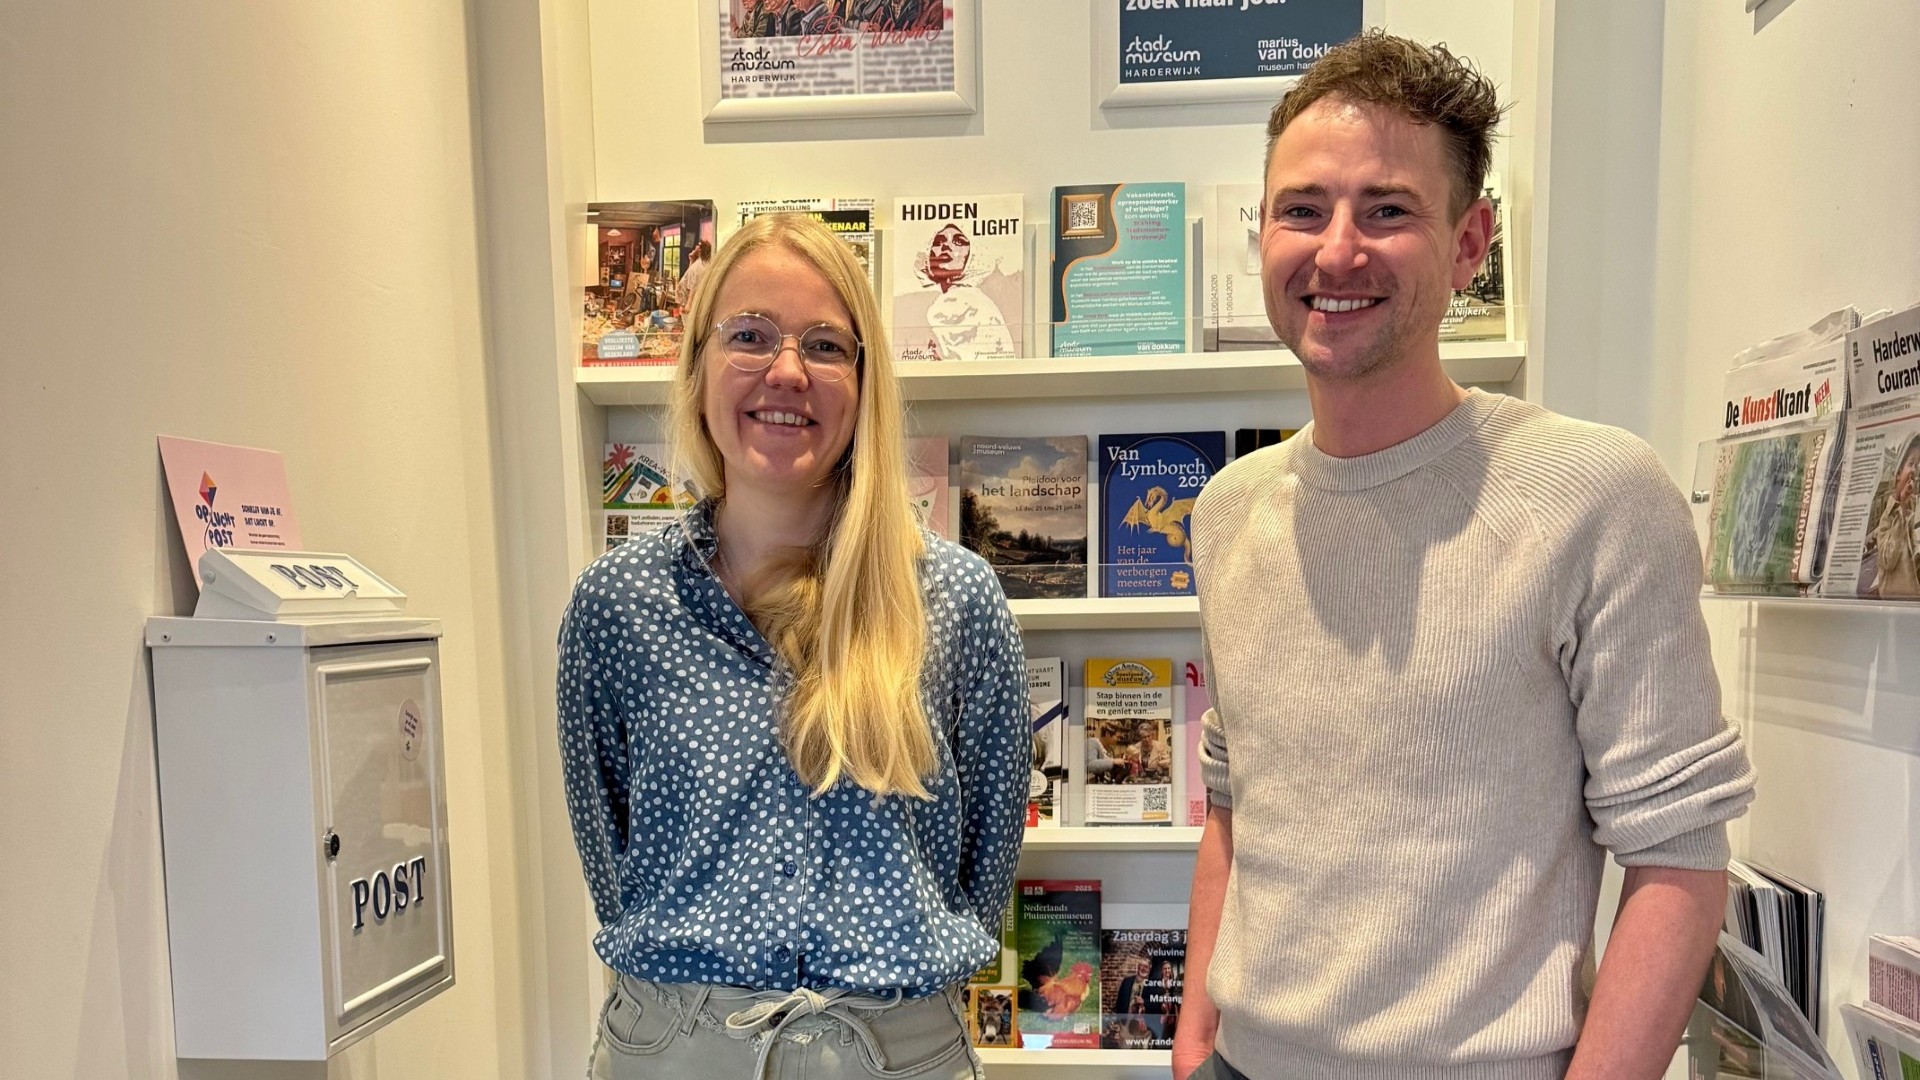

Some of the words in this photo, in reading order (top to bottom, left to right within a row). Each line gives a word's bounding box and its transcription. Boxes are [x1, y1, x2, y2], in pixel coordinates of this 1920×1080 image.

[1125, 33, 1173, 53] stads
[1257, 36, 1298, 48] marius
[731, 45, 771, 61] stads
[1125, 50, 1201, 64] museum
[1257, 48, 1287, 61] van
[731, 60, 795, 71] museum
[1125, 66, 1201, 77] HARDERWIJK
[1257, 63, 1295, 72] museum
[731, 74, 796, 83] HARDERWIJK
[753, 205, 811, 213] TENTOONSTELLING
[902, 202, 978, 221] HIDDEN
[1240, 206, 1260, 222] Ni
[972, 218, 1019, 236] LIGHT
[1454, 307, 1490, 318] Nijkerk,
[1725, 400, 1740, 429] De
[1741, 382, 1811, 426] KunstKrant
[1107, 446, 1139, 461] Van
[1120, 457, 1206, 481] Lymborch
[1061, 475, 1082, 483] voor
[1178, 474, 1213, 488] 202
[981, 483, 1006, 497] het
[1010, 483, 1082, 499] landschap
[1791, 508, 1809, 574] LALIQUE
[1802, 434, 1825, 502] MUSEUM
[208, 528, 234, 548] POST
[1117, 545, 1136, 555] Het
[1137, 544, 1157, 557] jaar
[1117, 557, 1135, 565] van
[1136, 555, 1149, 565] de
[269, 563, 360, 591] POST
[1117, 566, 1167, 578] verborgen
[1117, 579, 1162, 588] meesters
[1096, 691, 1114, 700] Stap
[1115, 691, 1142, 700] binnen
[1143, 691, 1151, 699] in
[1152, 691, 1163, 699] de
[1107, 708, 1132, 716] geniet
[350, 855, 427, 930] POST
[1023, 903, 1068, 912] Nederlands
[1023, 912, 1093, 920] Pluimveemuseum
[1112, 930, 1169, 944] Zaterdag
[1172, 930, 1180, 942] 3
[1143, 978, 1165, 987] Carel
